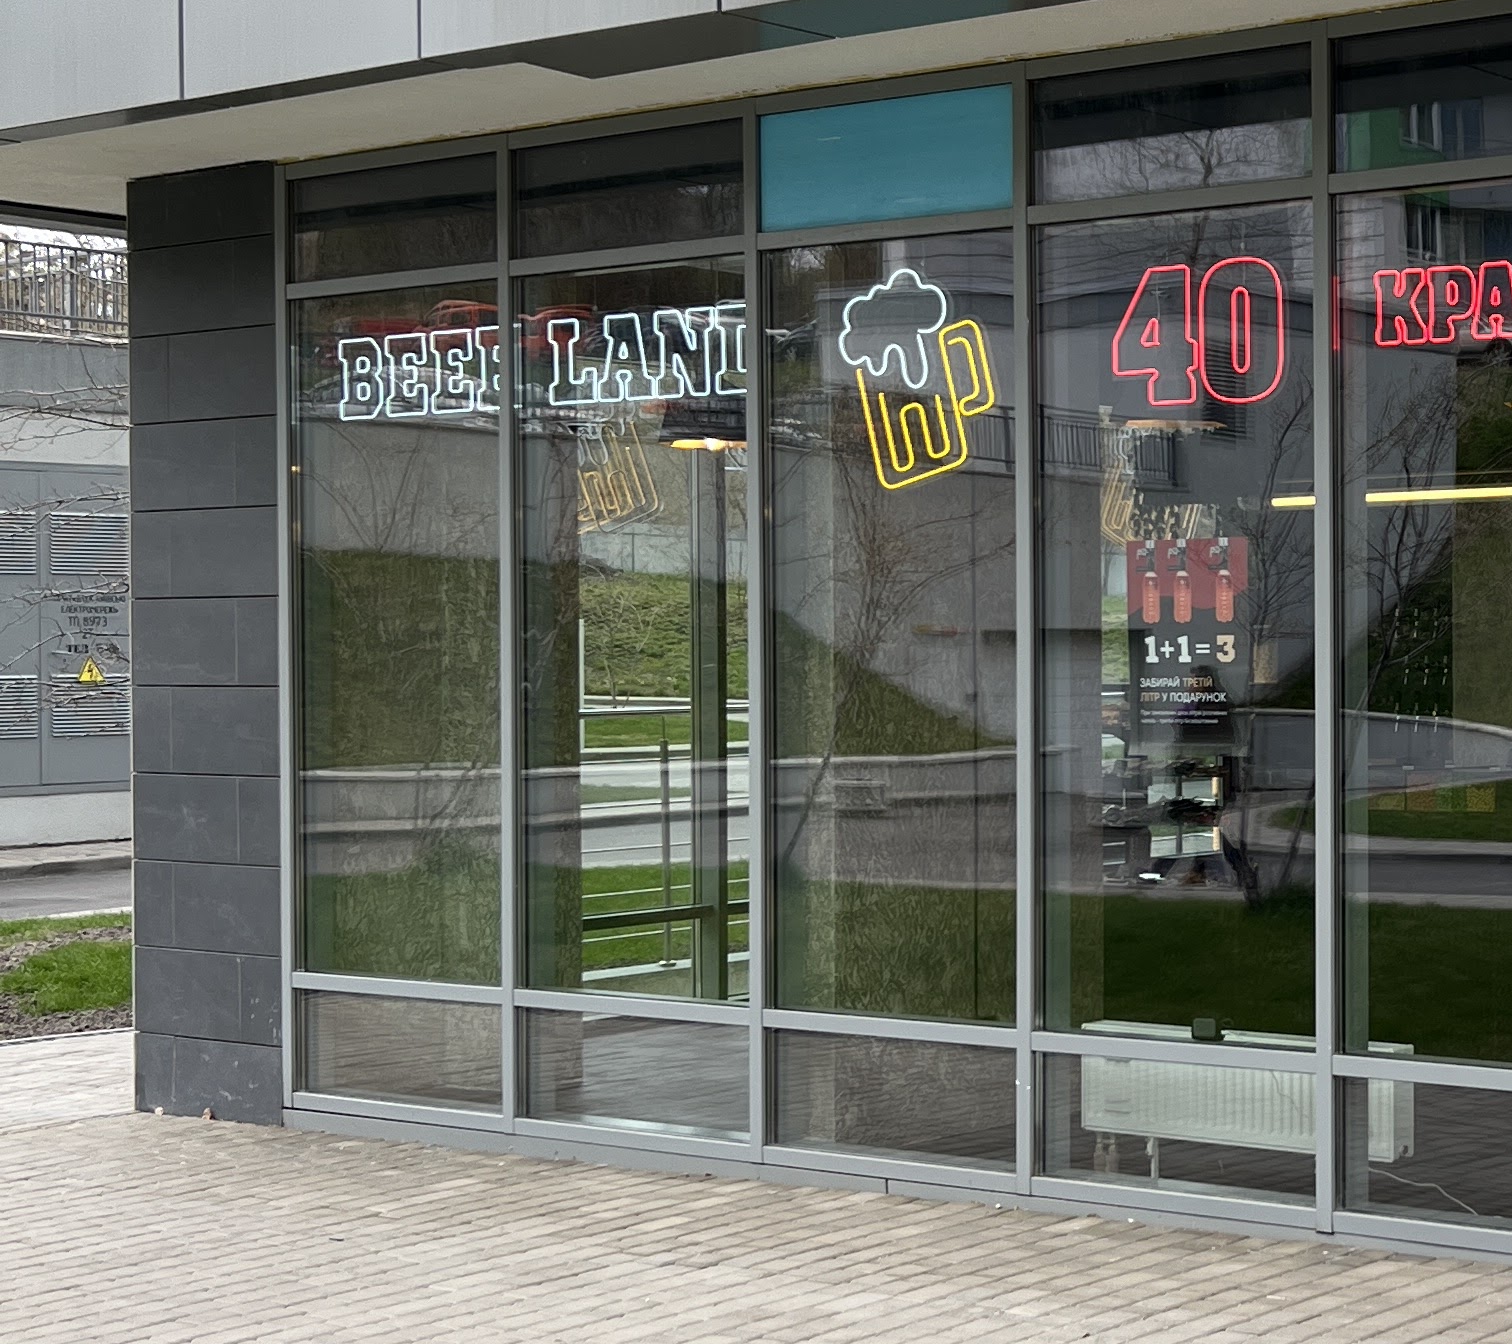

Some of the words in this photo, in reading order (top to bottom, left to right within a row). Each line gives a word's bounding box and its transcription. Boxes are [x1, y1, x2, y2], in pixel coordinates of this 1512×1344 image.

[1111, 255, 1285, 407] 40
[82, 615, 108, 627] 8973
[1139, 675, 1180, 688] ЗАБИРАЙ
[1182, 675, 1213, 688] ТРЕТІЙ
[1139, 691, 1160, 702] ЛІТР
[1161, 692, 1168, 702] У
[1169, 691, 1227, 704] ПОДАРУНОК
